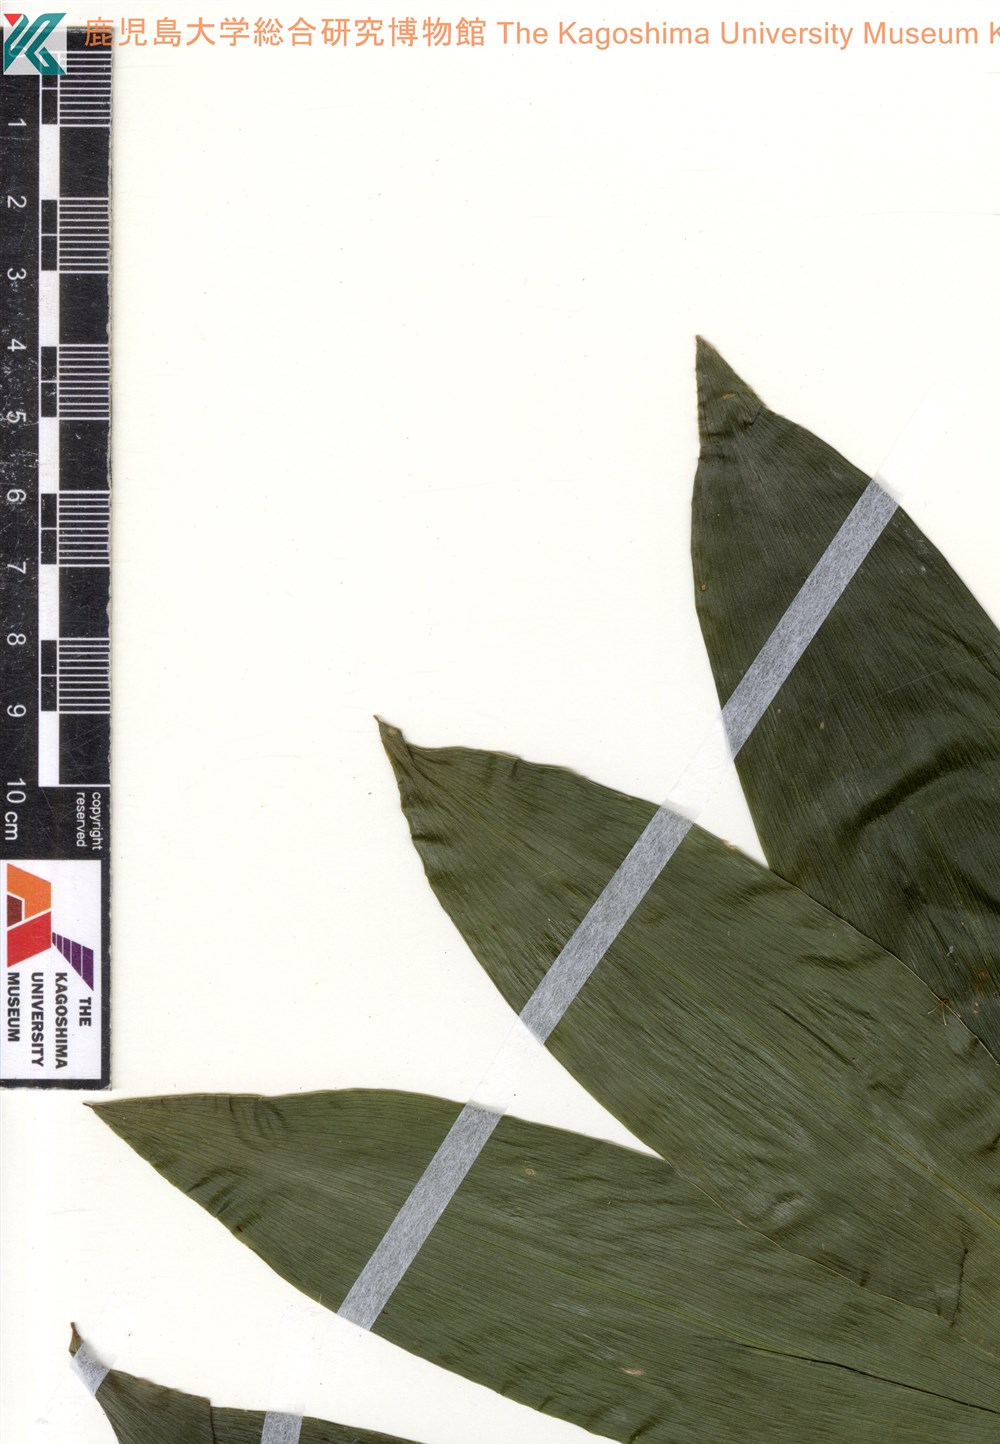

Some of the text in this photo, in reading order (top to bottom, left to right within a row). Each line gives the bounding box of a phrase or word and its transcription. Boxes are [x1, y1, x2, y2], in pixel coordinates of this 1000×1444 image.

[7, 118, 28, 127] 1
[6, 194, 28, 209] 2
[6, 267, 28, 282] 3
[6, 338, 28, 353] 4
[5, 410, 27, 424] 5
[6, 488, 27, 505] 6
[5, 560, 27, 575] 7
[6, 632, 27, 646] 8
[6, 704, 27, 718] 9
[4, 777, 27, 841] 10 cm
[75, 791, 88, 847] reserved
[89, 791, 104, 851] copyright
[7, 971, 21, 1042] MUSEUM
[78, 996, 92, 1027] THE
[30, 971, 45, 1068] UNIVERSITY
[54, 972, 69, 1070] KAGOSHIMA
